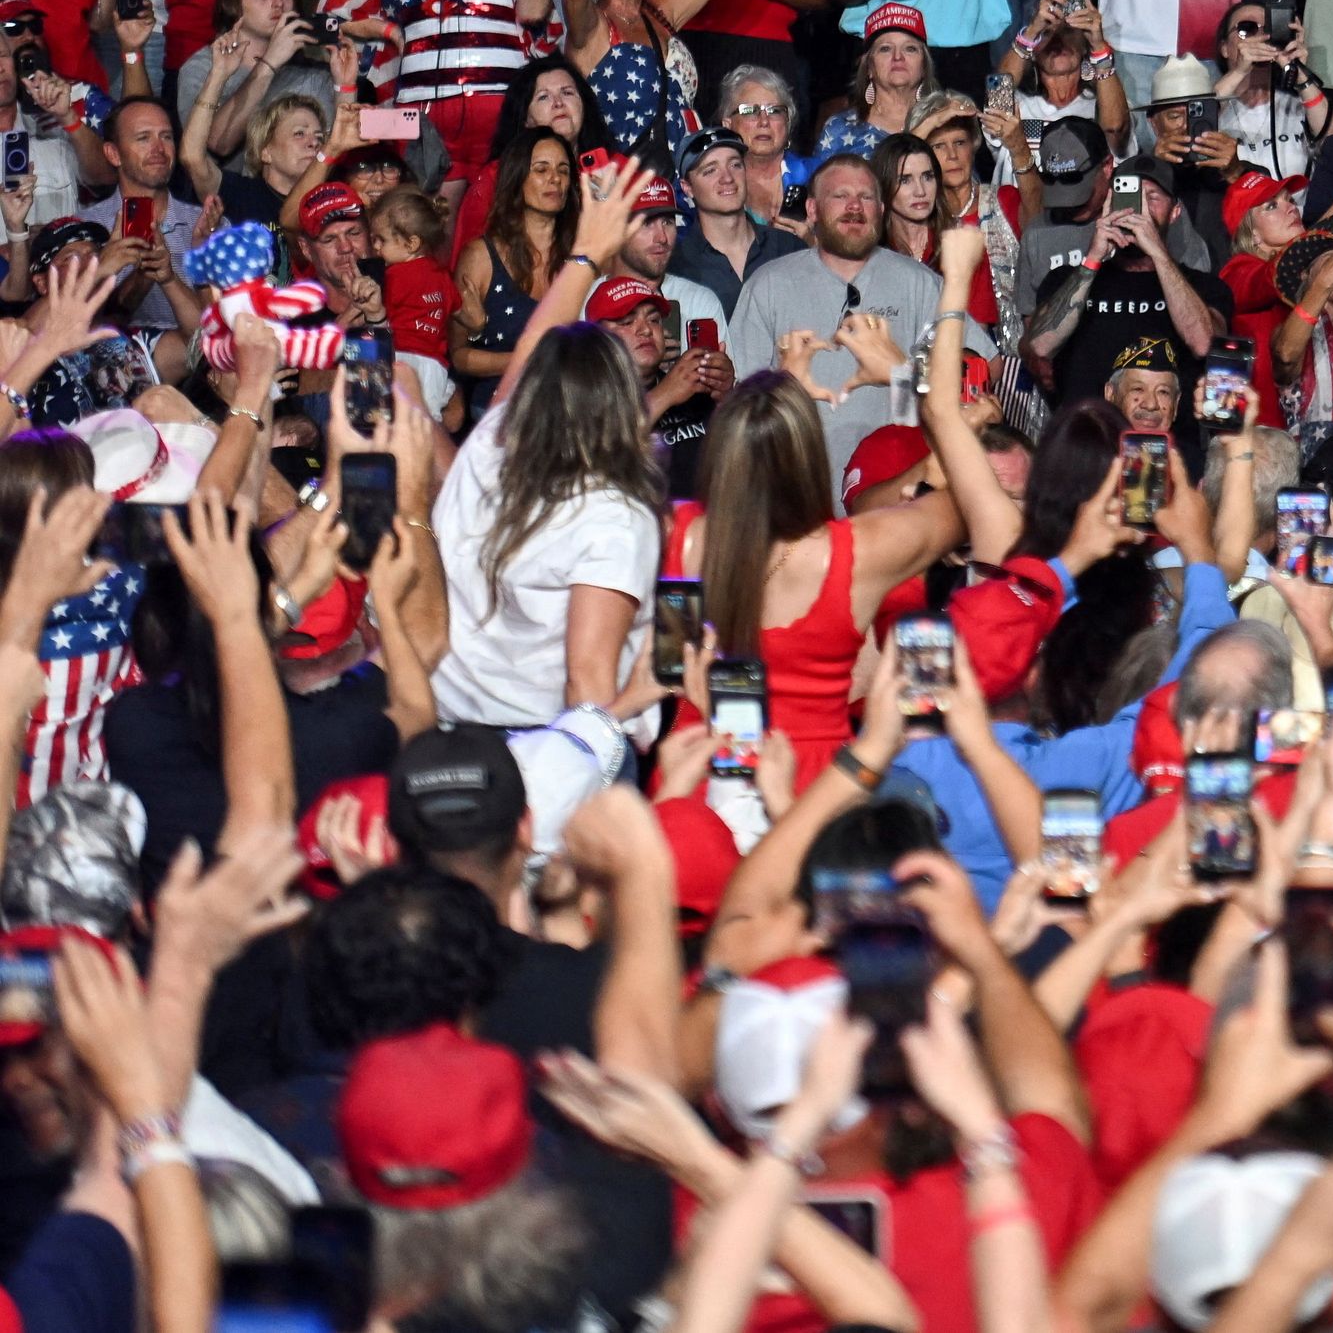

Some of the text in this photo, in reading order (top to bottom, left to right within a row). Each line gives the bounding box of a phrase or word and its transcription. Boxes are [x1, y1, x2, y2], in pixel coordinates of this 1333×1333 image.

[869, 7, 920, 25] MAKE AMERICA
[872, 16, 918, 32] GREAT AGAIN
[607, 281, 652, 297] MAKE AMERICA
[613, 290, 635, 302] GREAT
